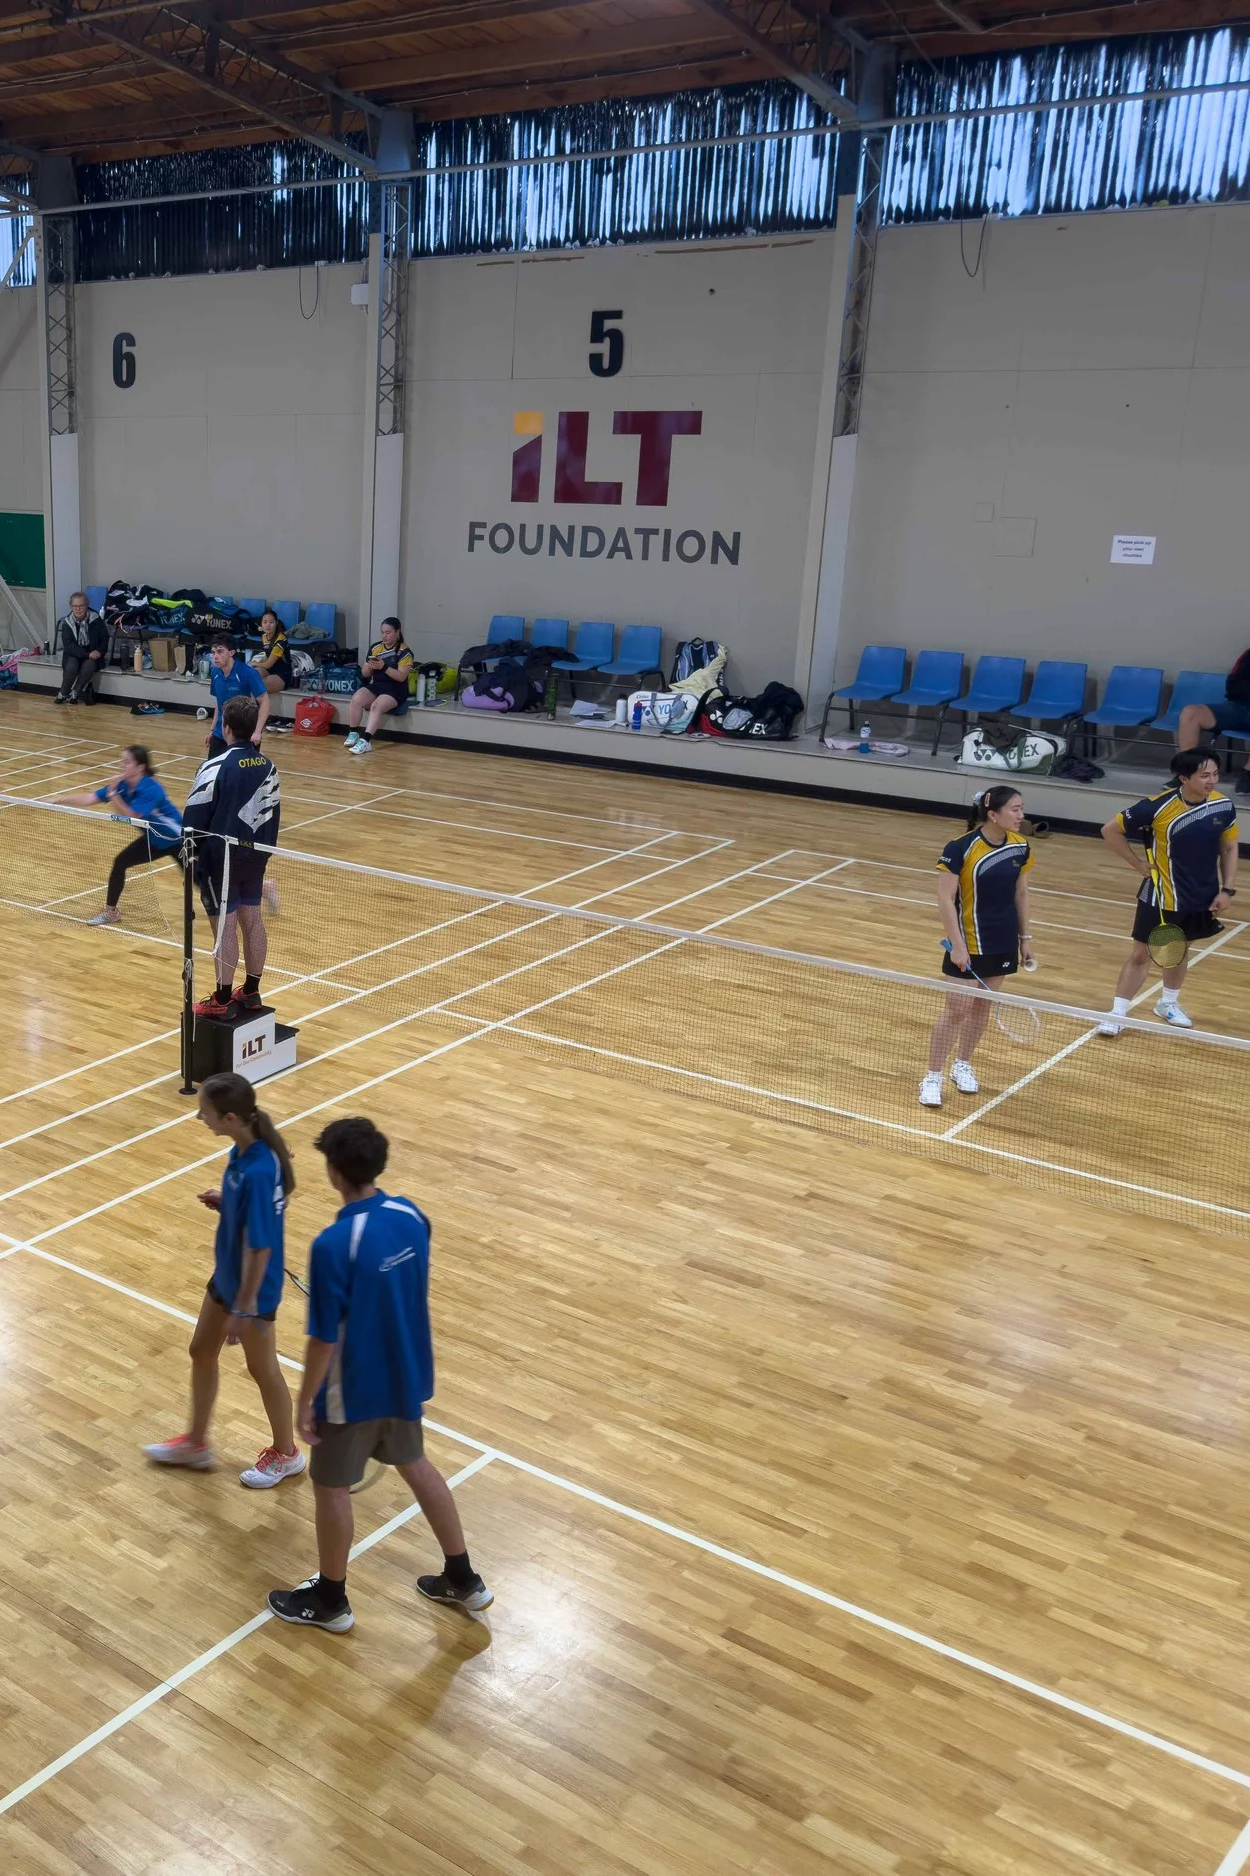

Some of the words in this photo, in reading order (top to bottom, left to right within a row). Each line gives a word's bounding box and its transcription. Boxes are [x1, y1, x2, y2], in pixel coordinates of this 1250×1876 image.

[588, 309, 624, 377] 5
[112, 331, 136, 389] 6
[467, 521, 741, 566] FOUNDATION
[206, 619, 232, 629] YONEX
[658, 700, 688, 715] YOX
[239, 757, 267, 768] OTAGO
